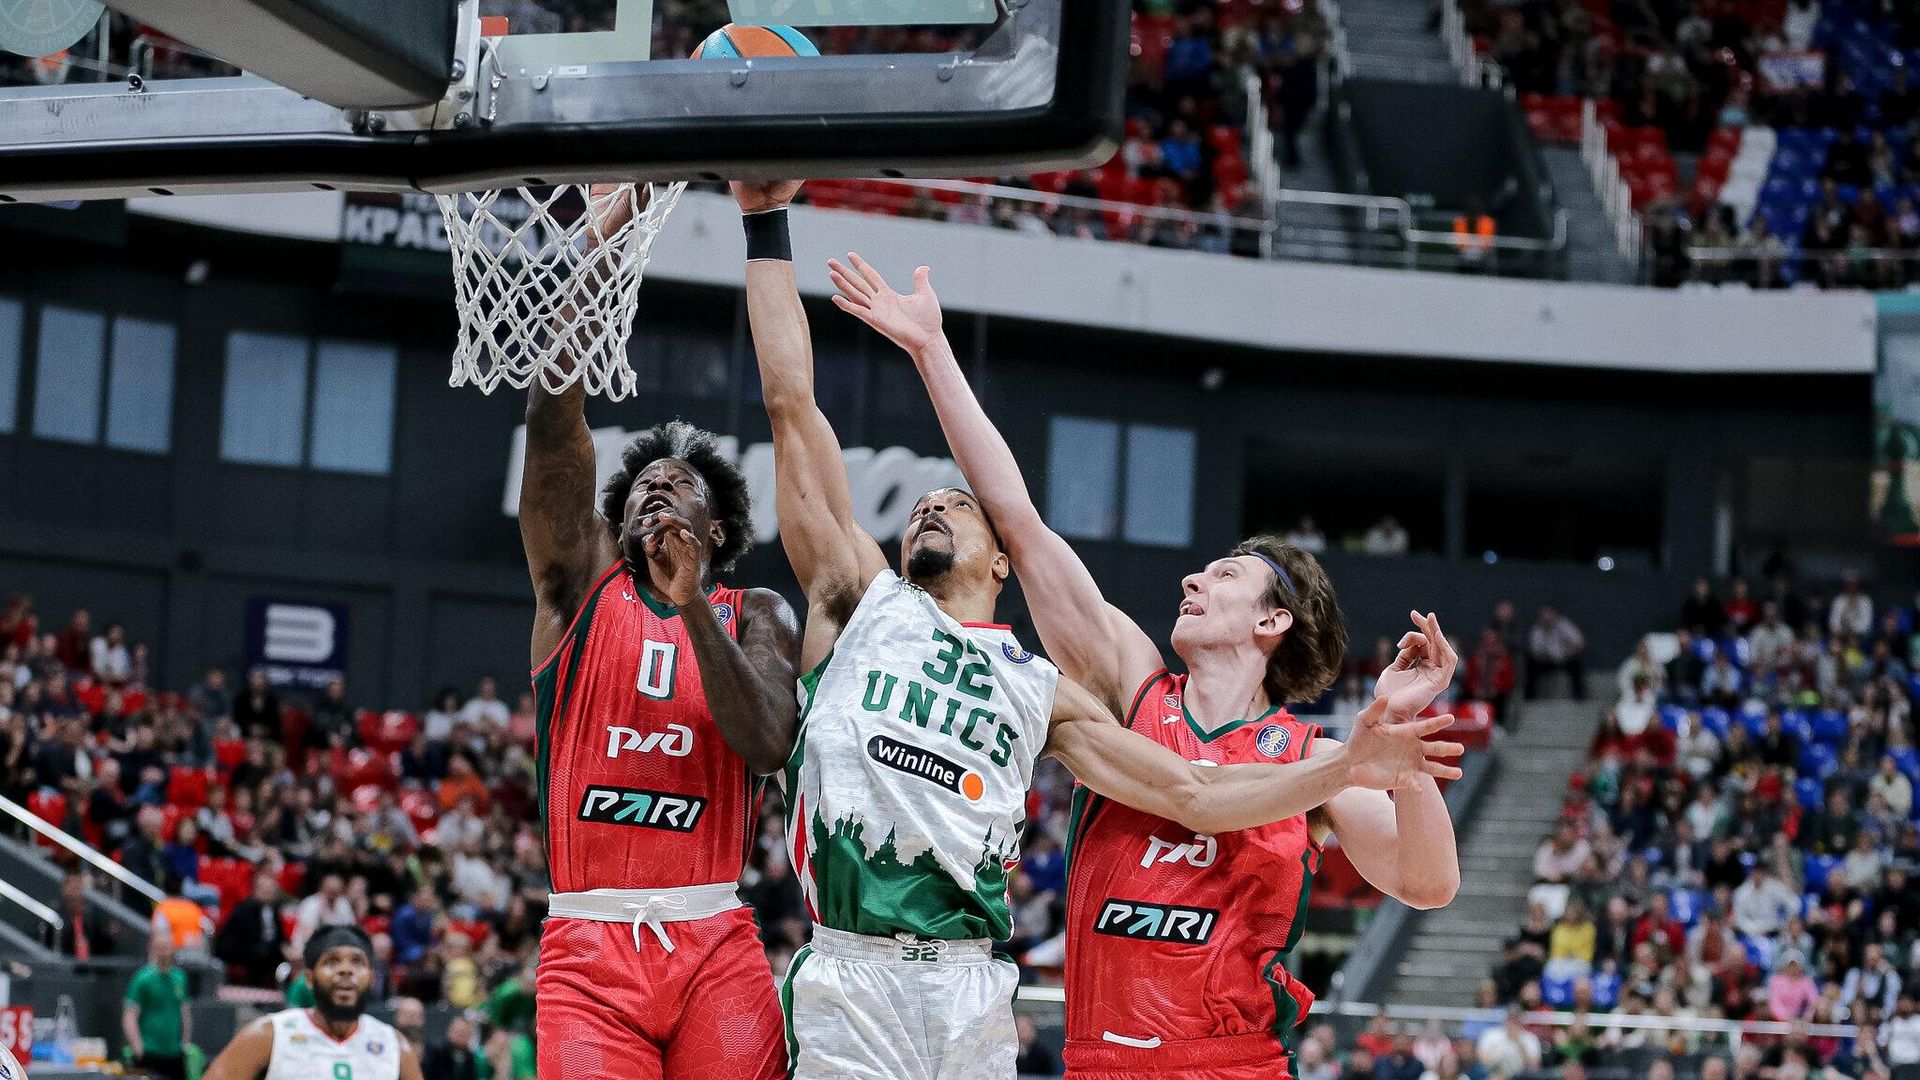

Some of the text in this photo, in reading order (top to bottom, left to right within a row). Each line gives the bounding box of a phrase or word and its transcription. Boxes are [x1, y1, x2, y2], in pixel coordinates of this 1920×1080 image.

[637, 638, 680, 700] 0
[923, 627, 994, 701] 32
[861, 670, 1020, 768] UNICS
[878, 739, 956, 786] Winline
[582, 789, 701, 829] PARI
[1098, 903, 1214, 940] PARI
[902, 946, 938, 962] 32
